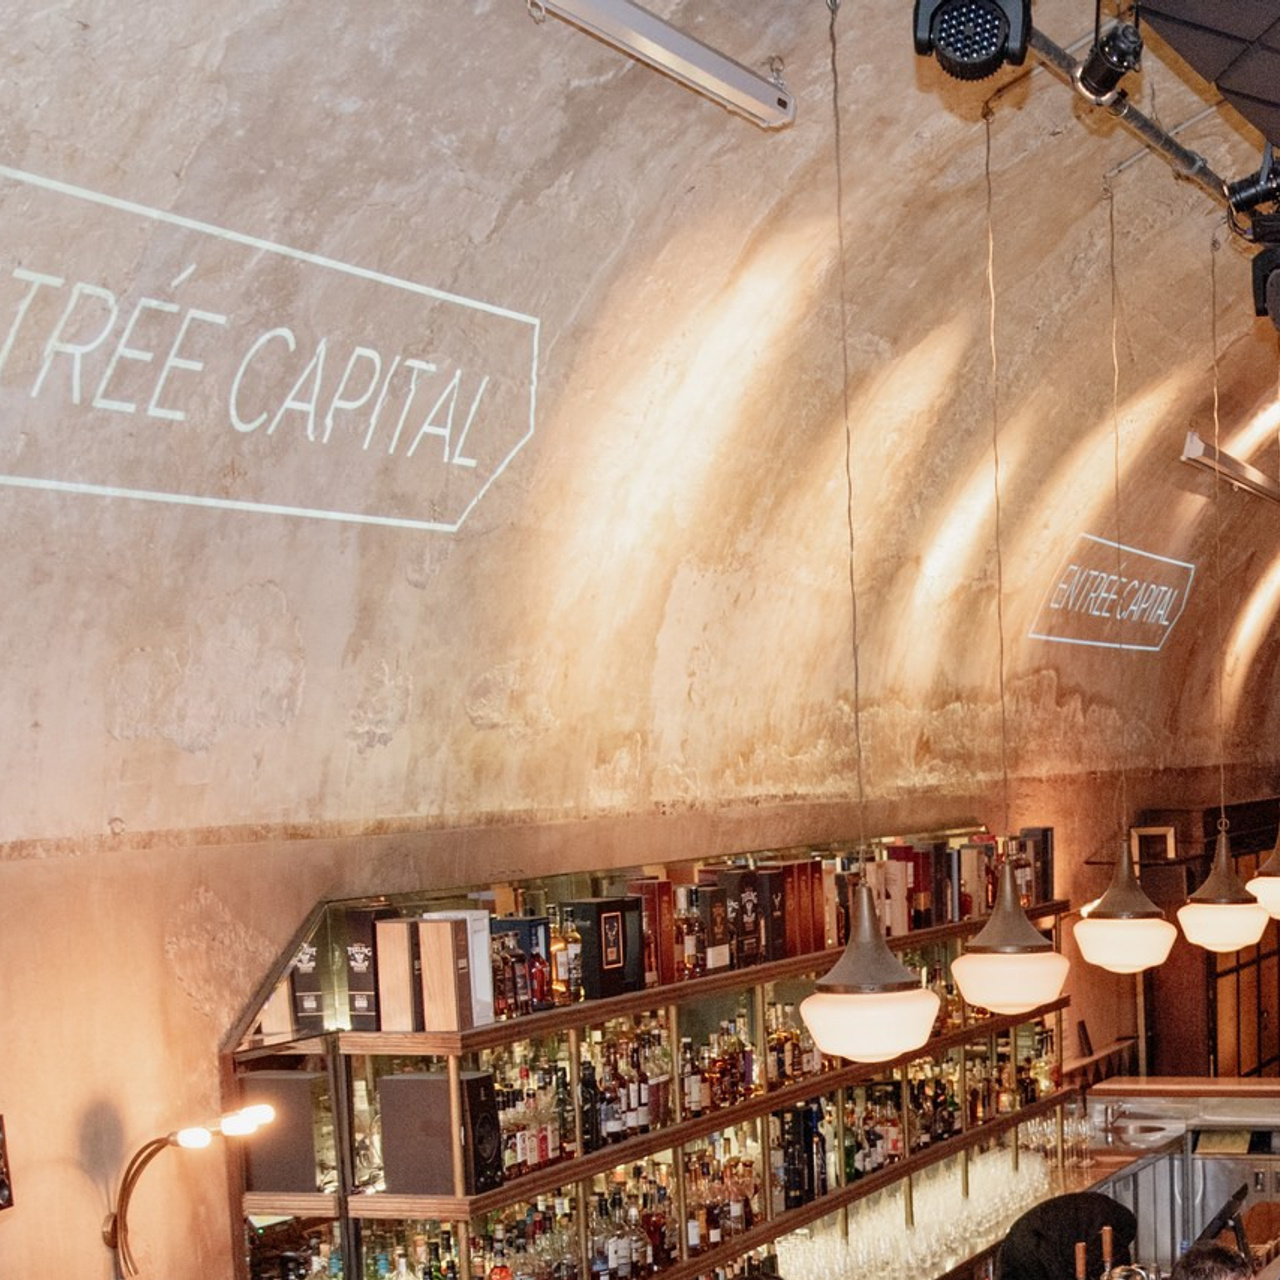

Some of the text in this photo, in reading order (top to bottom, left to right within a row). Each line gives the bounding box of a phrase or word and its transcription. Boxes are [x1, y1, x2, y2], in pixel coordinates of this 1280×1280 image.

[229, 327, 489, 467] CAPITAL
[1050, 562, 1178, 626] ENTRÉE CAPITAL
